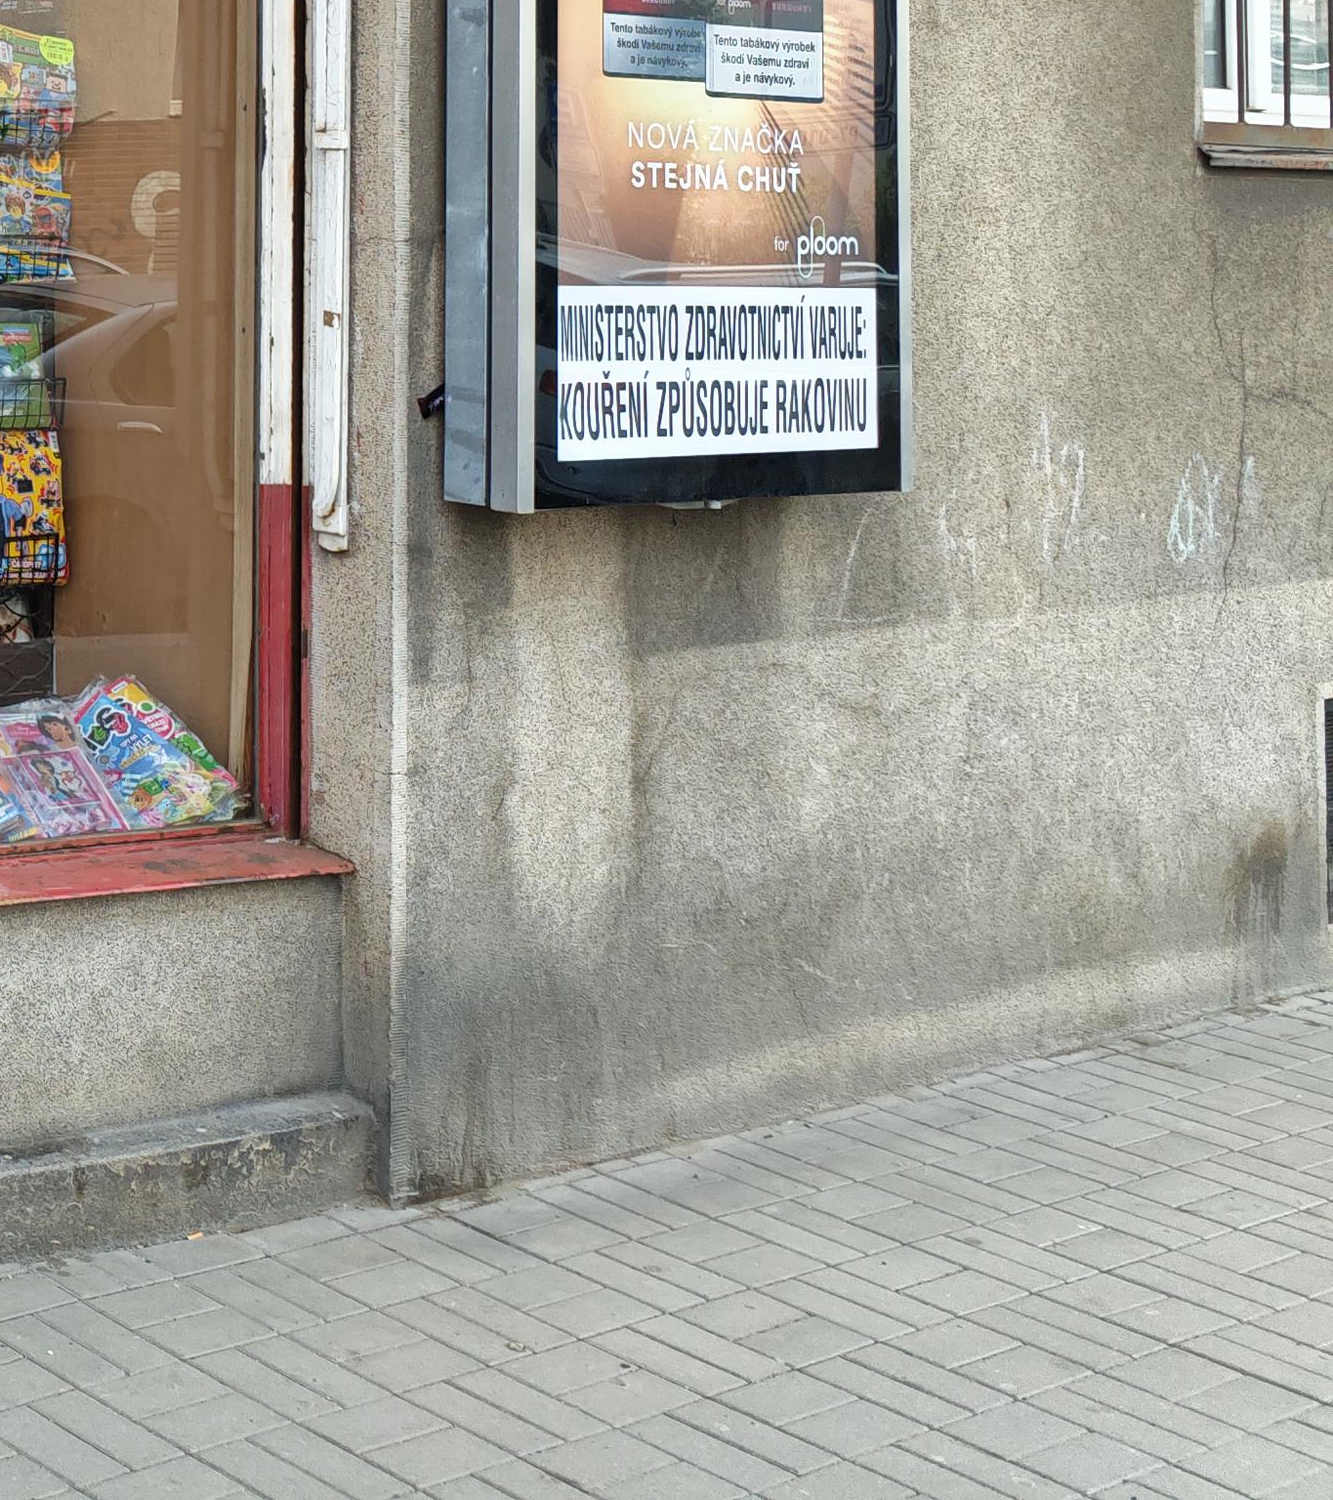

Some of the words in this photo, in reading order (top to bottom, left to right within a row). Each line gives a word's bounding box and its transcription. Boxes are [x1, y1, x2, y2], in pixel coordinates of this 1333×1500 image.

[610, 23, 633, 33] Tento
[635, 25, 673, 37] tabákový
[616, 38, 640, 49] škodí
[641, 39, 674, 52] Vašemu
[676, 42, 701, 53] zdraví
[714, 35, 738, 47] Tento
[740, 37, 780, 51] tabákový
[781, 40, 815, 53] výrobek
[630, 56, 635, 64] a
[637, 54, 645, 66] je
[647, 54, 688, 68] návykový.
[721, 53, 744, 64] škodí
[747, 54, 782, 68] Vašemu
[784, 57, 809, 69] zdraví
[735, 73, 741, 82] a
[742, 71, 751, 83] je
[753, 72, 796, 87] návykový.
[628, 119, 699, 150] NOVÁ
[708, 124, 804, 156] ZNAČKA
[631, 159, 730, 191] STEJNÁ
[736, 159, 802, 195] CHUŤ
[772, 234, 790, 254] for
[796, 215, 859, 278] ploom
[560, 302, 679, 364] MINISTERSTVO
[685, 292, 806, 361] ZDRAVOTNICTVÍ
[809, 298, 867, 360] VARUJE:
[559, 369, 651, 443] KOUŘENÍ
[656, 366, 769, 439] ZPŮSOBUJE
[775, 377, 867, 434] RAKOVINU
